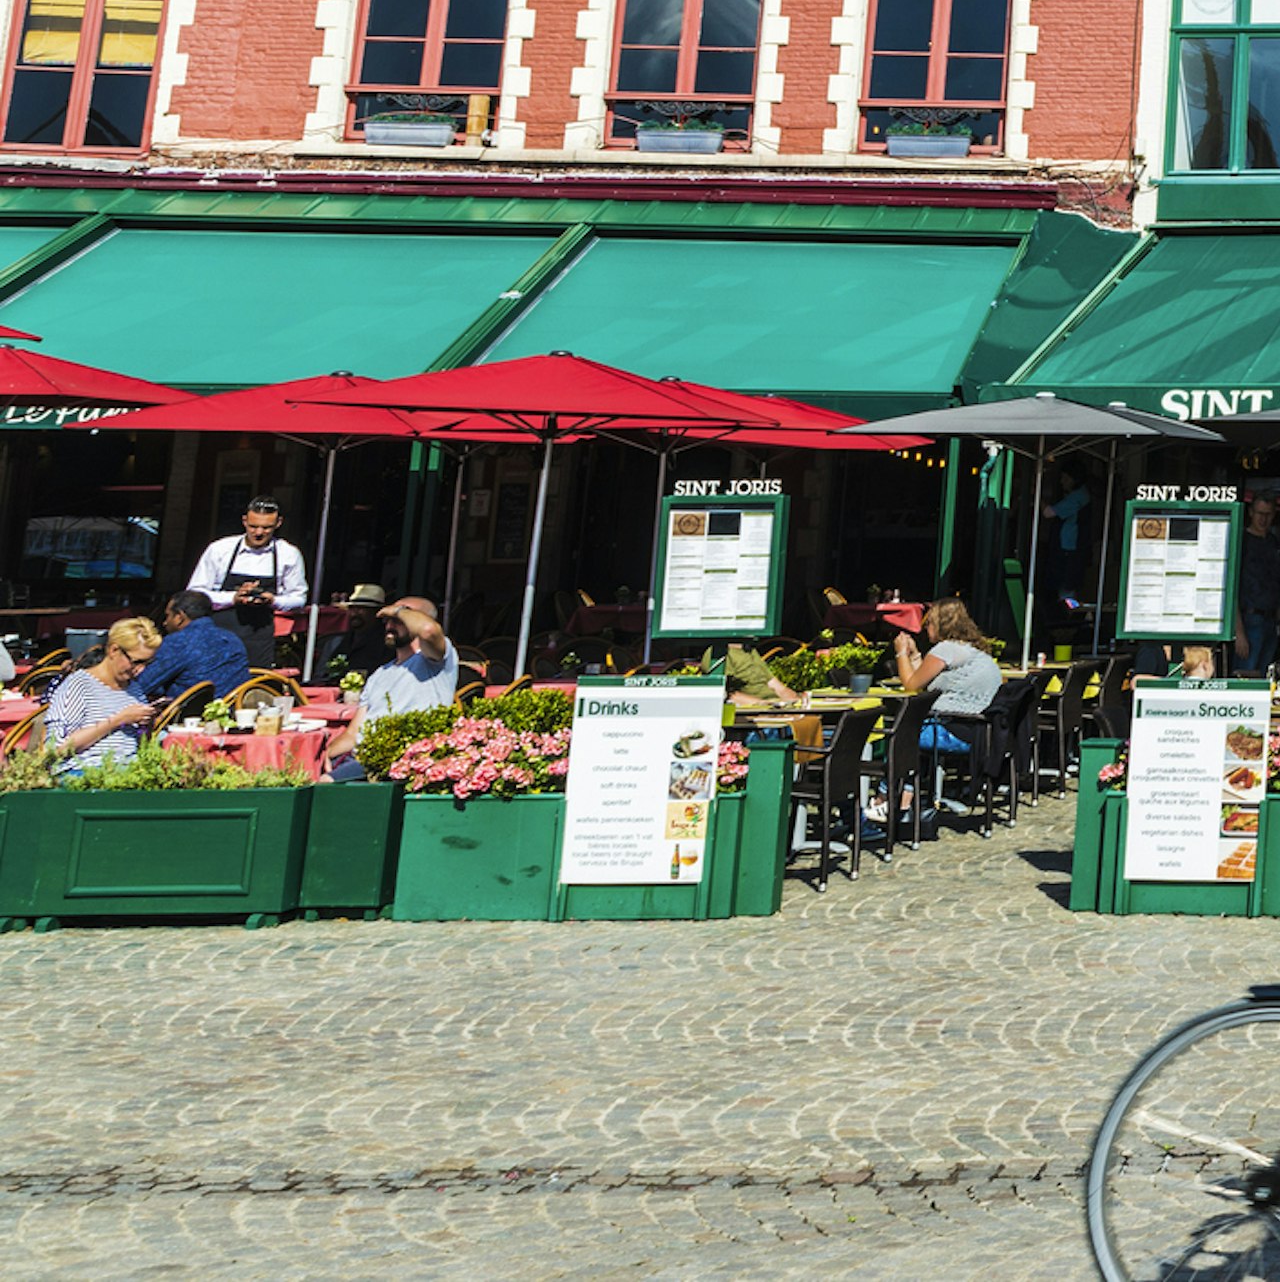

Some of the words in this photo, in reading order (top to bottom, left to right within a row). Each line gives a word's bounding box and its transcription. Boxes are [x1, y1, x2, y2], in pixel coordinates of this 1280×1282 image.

[1160, 389, 1274, 422] SINT
[673, 480, 721, 496] SINT
[725, 479, 782, 495] JORIS
[1136, 485, 1181, 501] SINT
[1184, 486, 1238, 502] JORIS
[624, 678, 648, 686] SINT
[650, 678, 677, 686] JORIS
[588, 701, 639, 715] Drinks
[1199, 702, 1255, 718] Snacks
